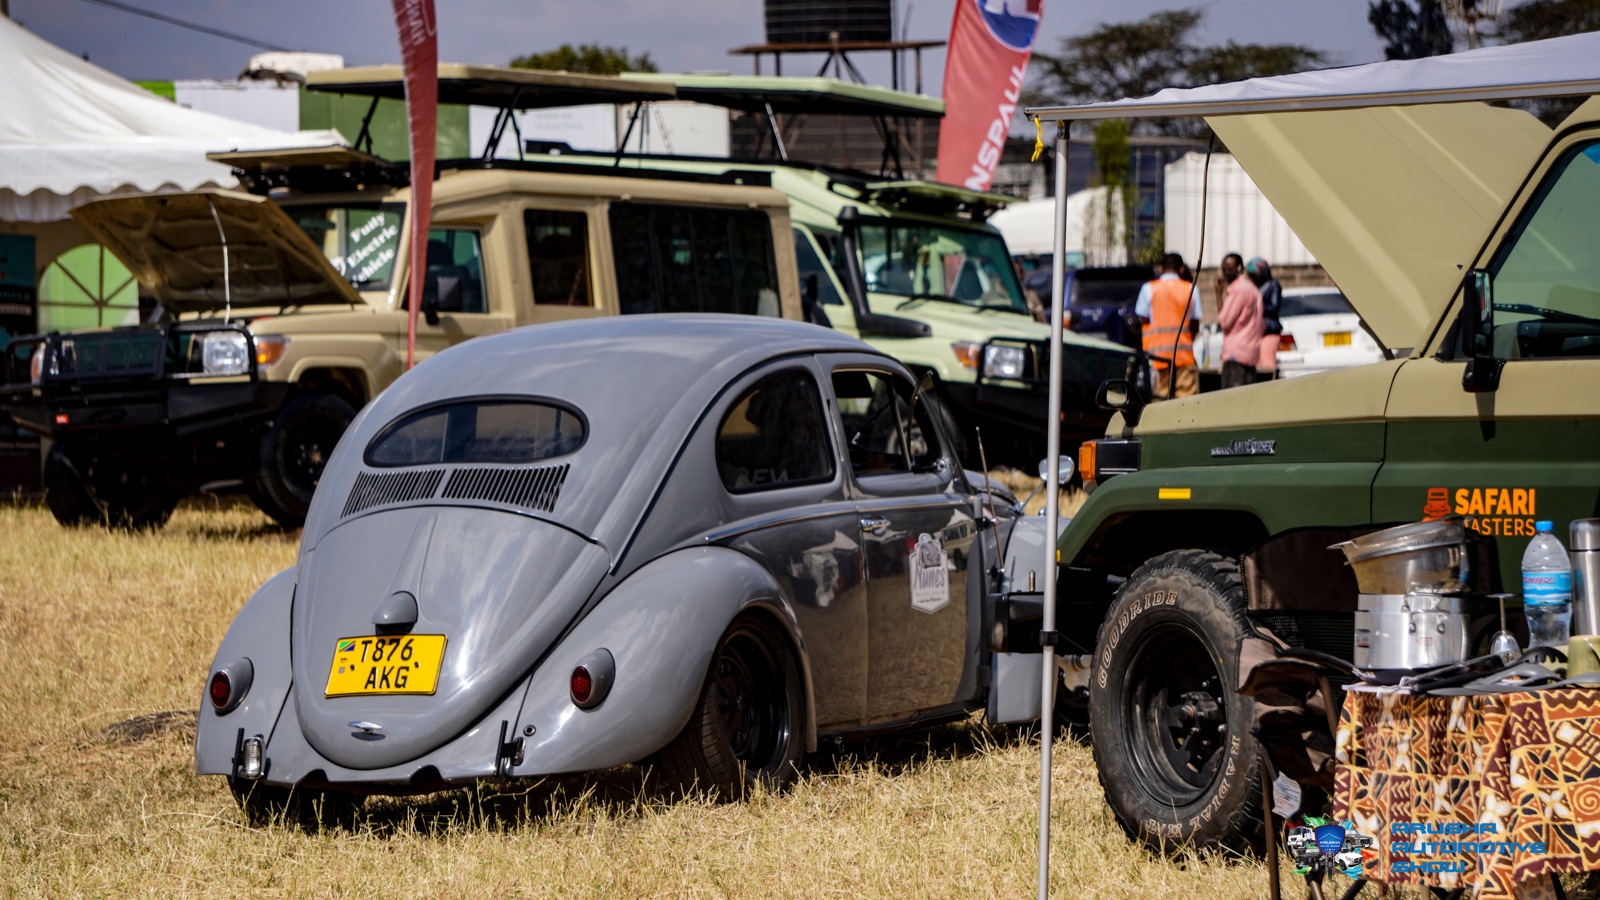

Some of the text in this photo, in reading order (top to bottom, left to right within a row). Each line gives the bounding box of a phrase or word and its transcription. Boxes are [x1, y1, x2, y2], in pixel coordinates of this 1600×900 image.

[350, 212, 385, 243] Fully
[347, 225, 398, 268] Electric
[1454, 487, 1536, 515] SAFARI
[913, 558, 946, 590] Nunes
[361, 638, 414, 662] T876
[1098, 591, 1179, 688] GOODRIDE
[364, 666, 410, 689] AKG
[1190, 735, 1241, 831] RADIAL
